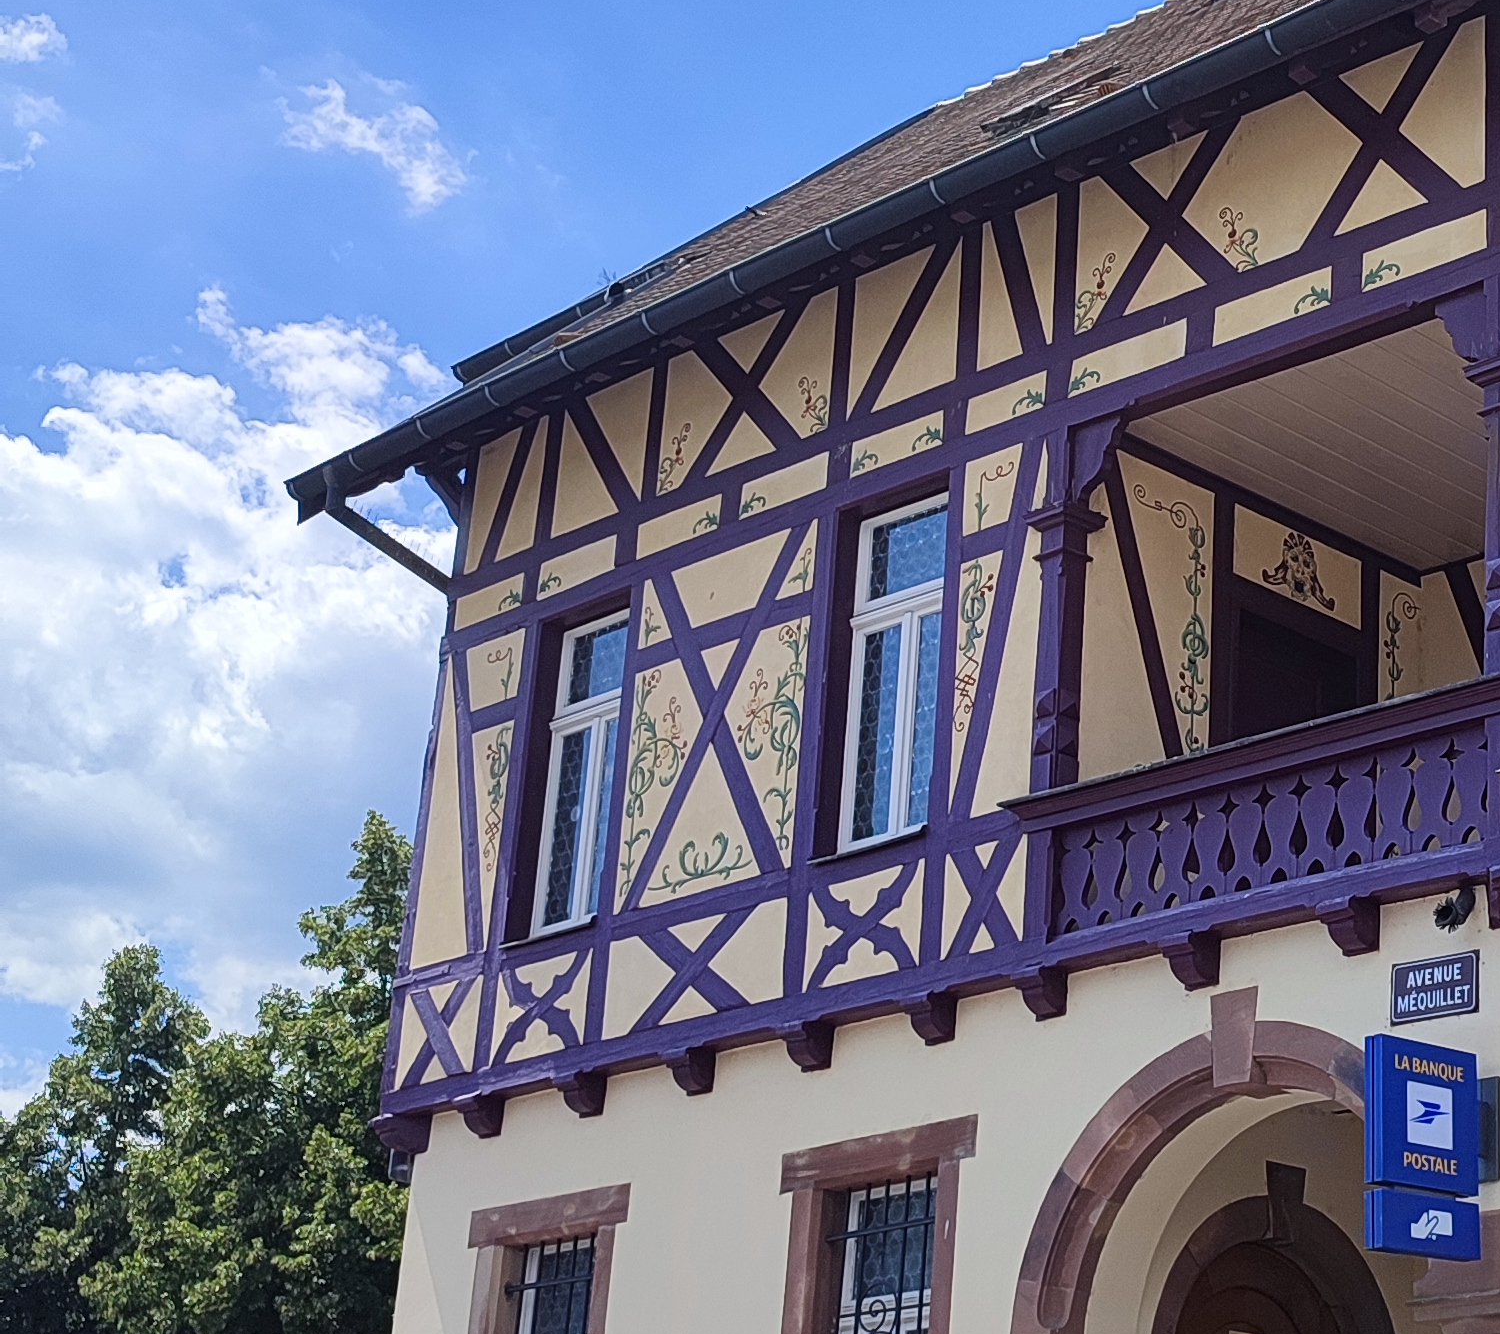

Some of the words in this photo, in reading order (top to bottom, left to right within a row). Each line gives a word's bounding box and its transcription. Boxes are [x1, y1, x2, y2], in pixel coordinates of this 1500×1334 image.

[1406, 962, 1462, 989] AVENUE
[1397, 984, 1471, 1014] MÉQUILLET
[1394, 1053, 1410, 1072] LA
[1413, 1058, 1465, 1083] BANQUE
[1403, 1151, 1458, 1176] POSTALE
